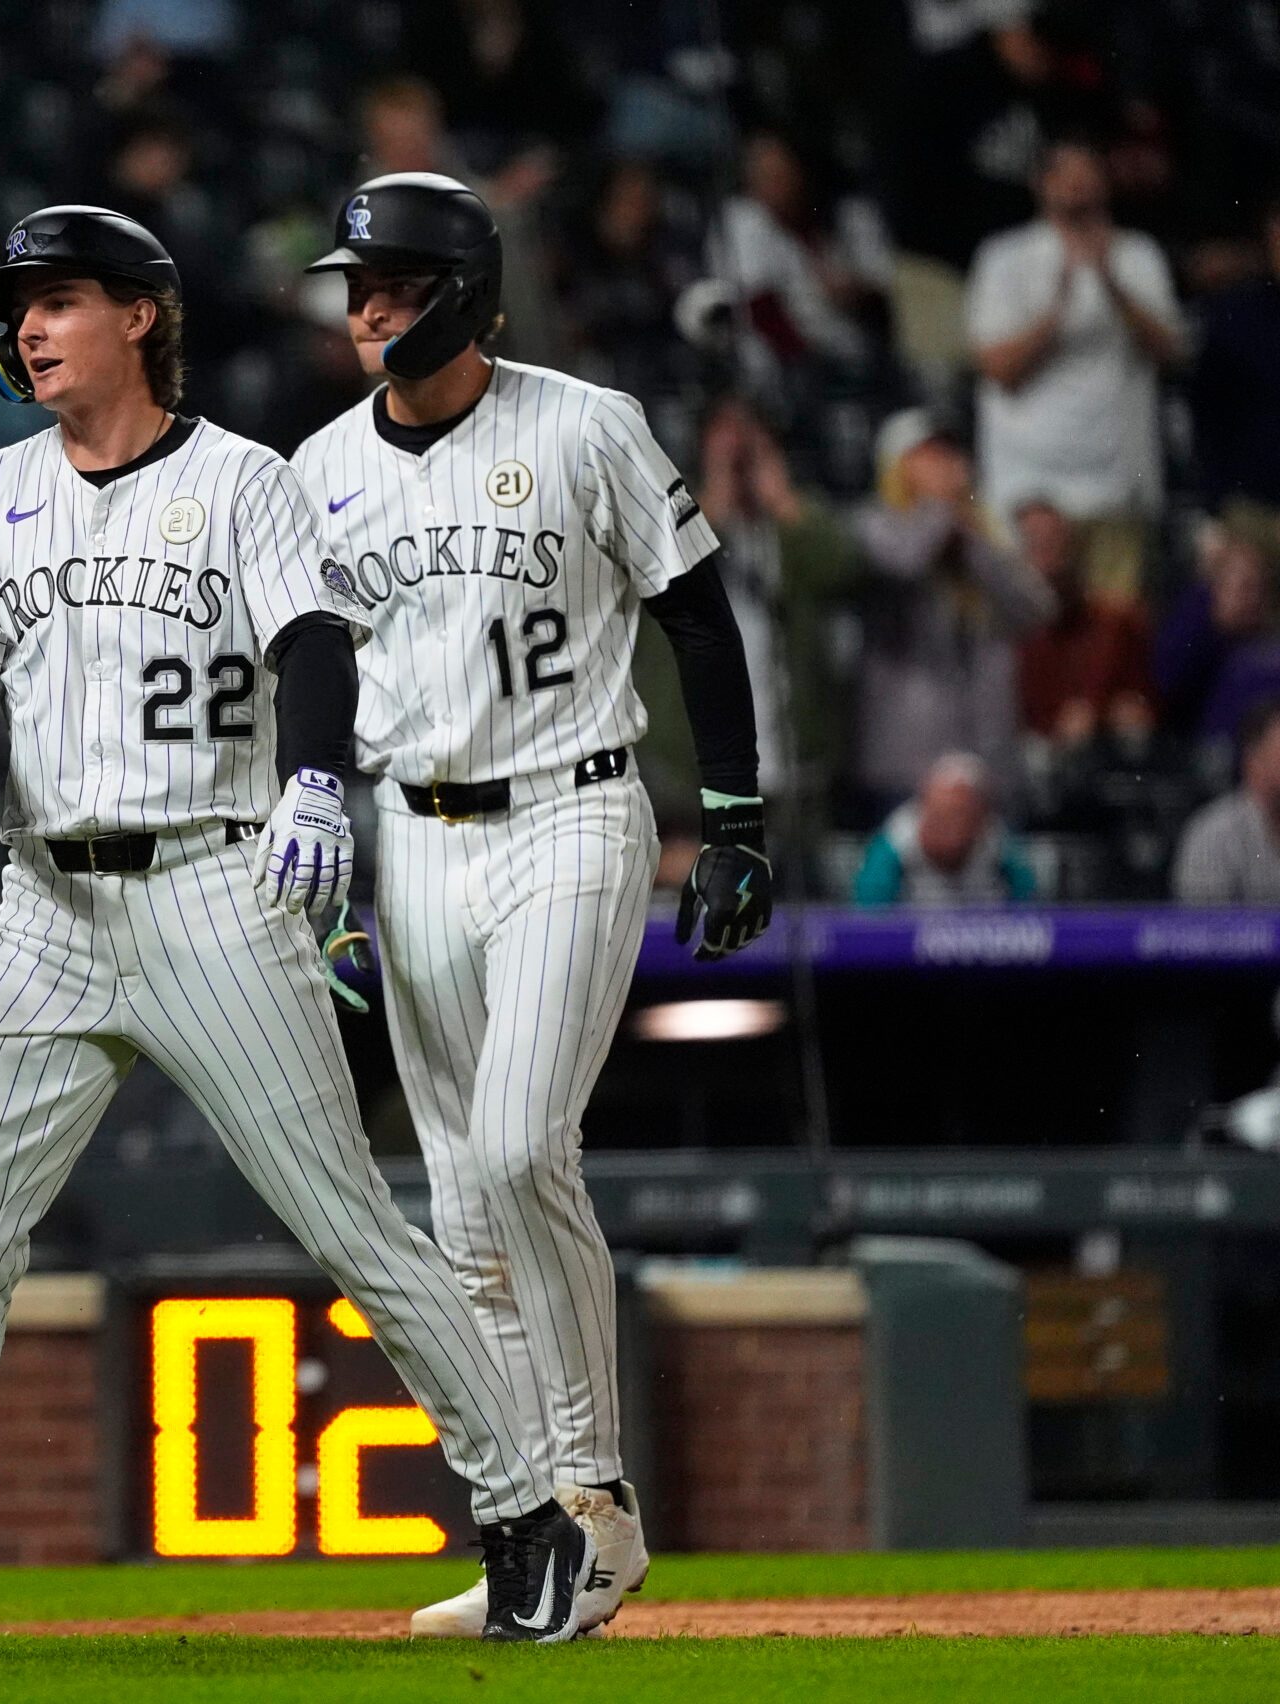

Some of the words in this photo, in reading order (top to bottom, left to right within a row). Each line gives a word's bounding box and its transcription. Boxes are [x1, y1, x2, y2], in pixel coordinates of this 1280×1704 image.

[495, 470, 521, 496] 21
[168, 507, 195, 532] 21
[488, 608, 575, 699] 12
[139, 652, 256, 744] 22
[296, 813, 342, 834] franklin
[152, 1298, 447, 1556] 02
